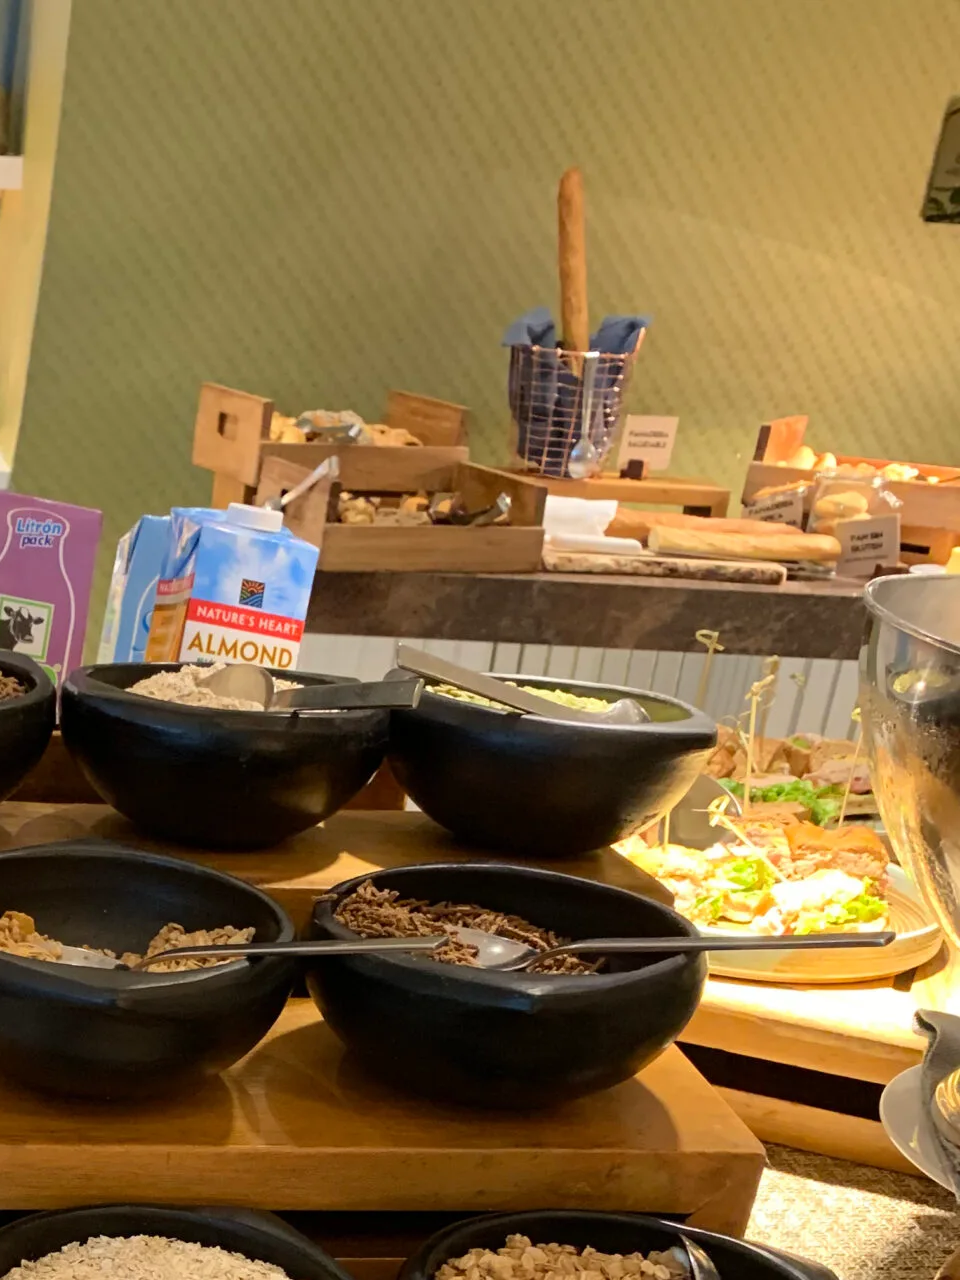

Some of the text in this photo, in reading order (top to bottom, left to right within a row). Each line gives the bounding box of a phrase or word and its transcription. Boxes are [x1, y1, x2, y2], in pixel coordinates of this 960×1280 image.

[16, 518, 62, 536] Litrón
[20, 535, 53, 549] pack
[196, 605, 297, 635] NATURE'S HEART
[187, 631, 293, 668] ALMOND
